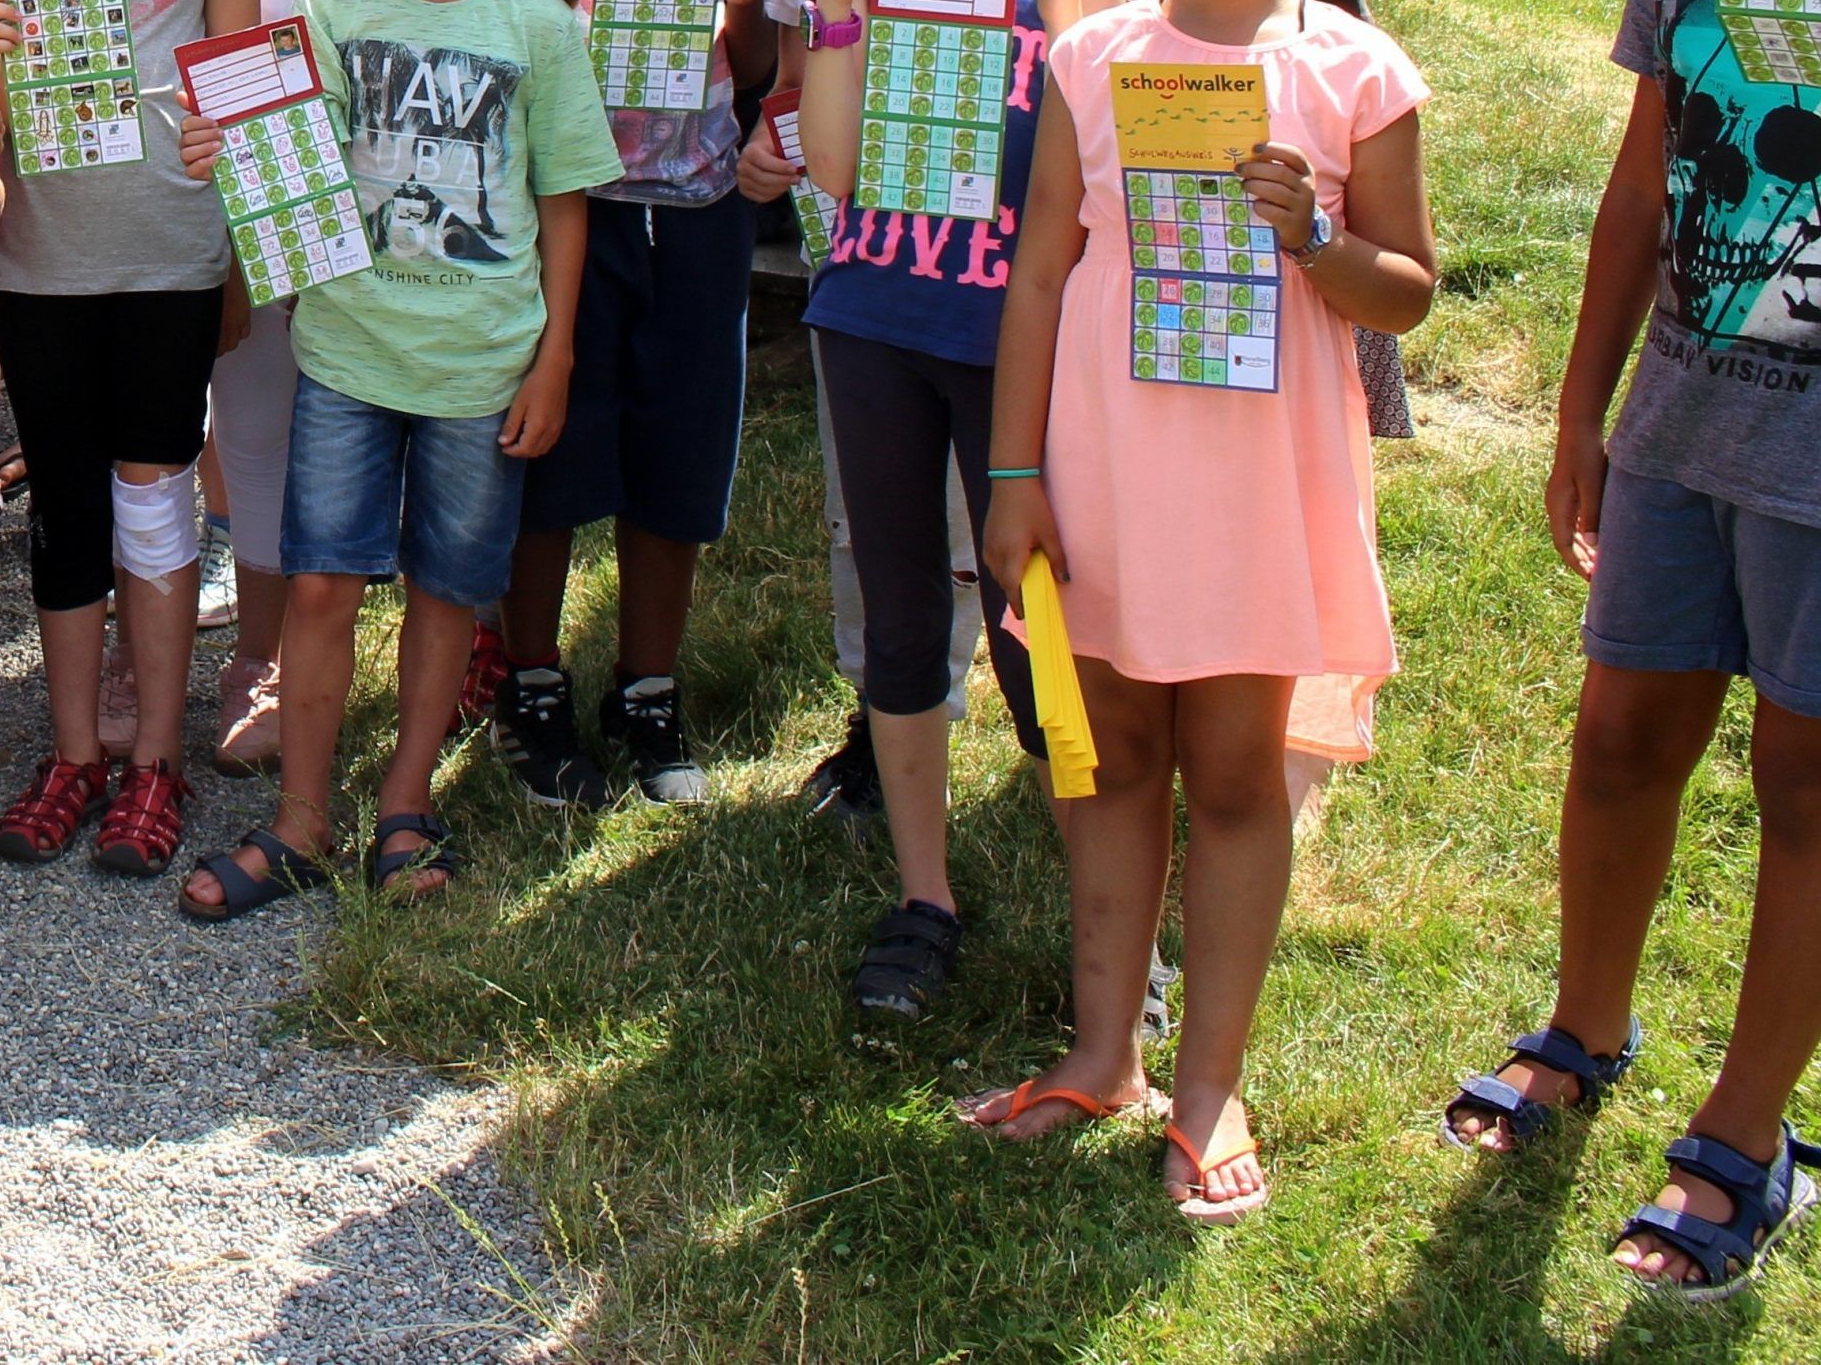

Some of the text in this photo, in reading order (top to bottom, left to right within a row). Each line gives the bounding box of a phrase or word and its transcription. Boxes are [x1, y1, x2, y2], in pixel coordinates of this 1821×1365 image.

[901, 28, 907, 37] 2
[947, 33, 953, 41] 4
[944, 56, 954, 65] 10
[990, 60, 1000, 69] 12
[896, 74, 998, 93] 14 16 18
[1120, 73, 1255, 92] schoolwalker
[893, 98, 996, 115] 20 22 24
[891, 126, 903, 135] 26
[982, 137, 993, 145] 30
[935, 153, 946, 161] 34
[886, 193, 897, 202] 42
[829, 203, 1016, 288] LOVE
[1162, 253, 1222, 266] 20 22
[439, 272, 475, 285] CITY
[1163, 285, 1176, 295] 26
[1707, 355, 1811, 393] VISION
